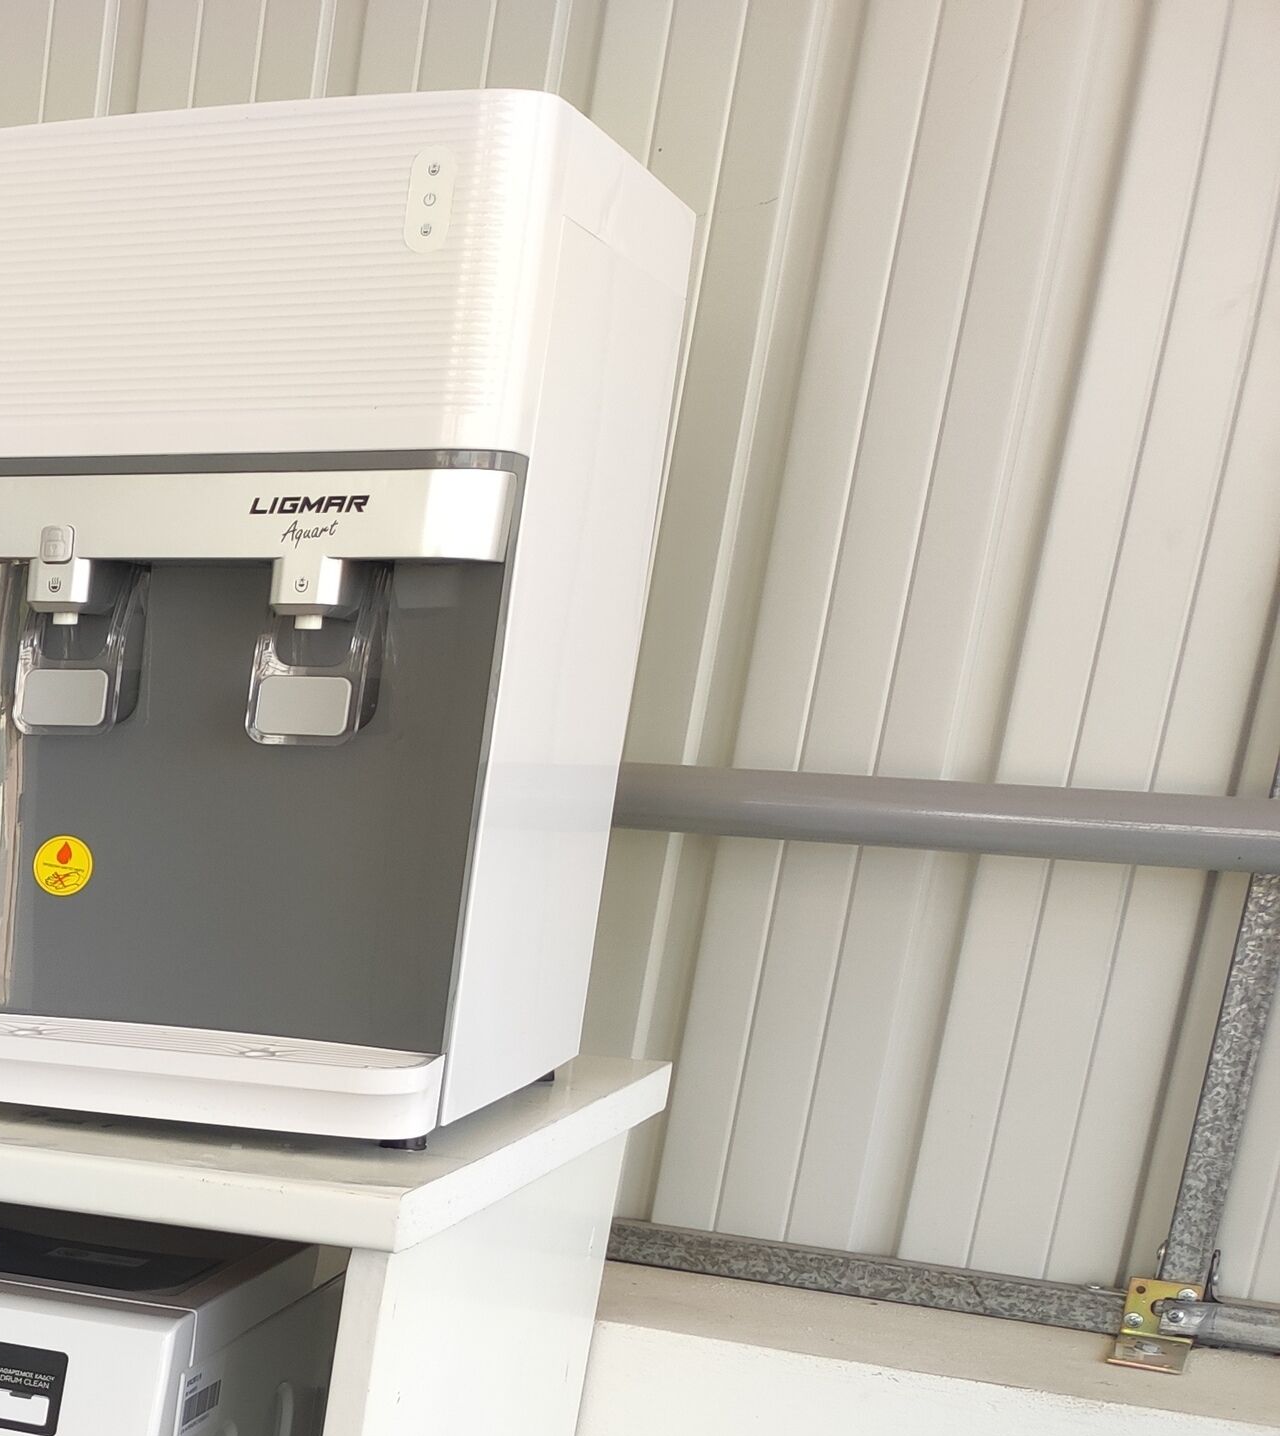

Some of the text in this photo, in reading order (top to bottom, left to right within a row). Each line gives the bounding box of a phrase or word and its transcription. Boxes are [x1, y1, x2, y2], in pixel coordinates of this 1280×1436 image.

[248, 494, 370, 514] LIGMAR
[281, 519, 338, 548] Aquart
[0, 1374, 50, 1389] DRUM CLEAN
